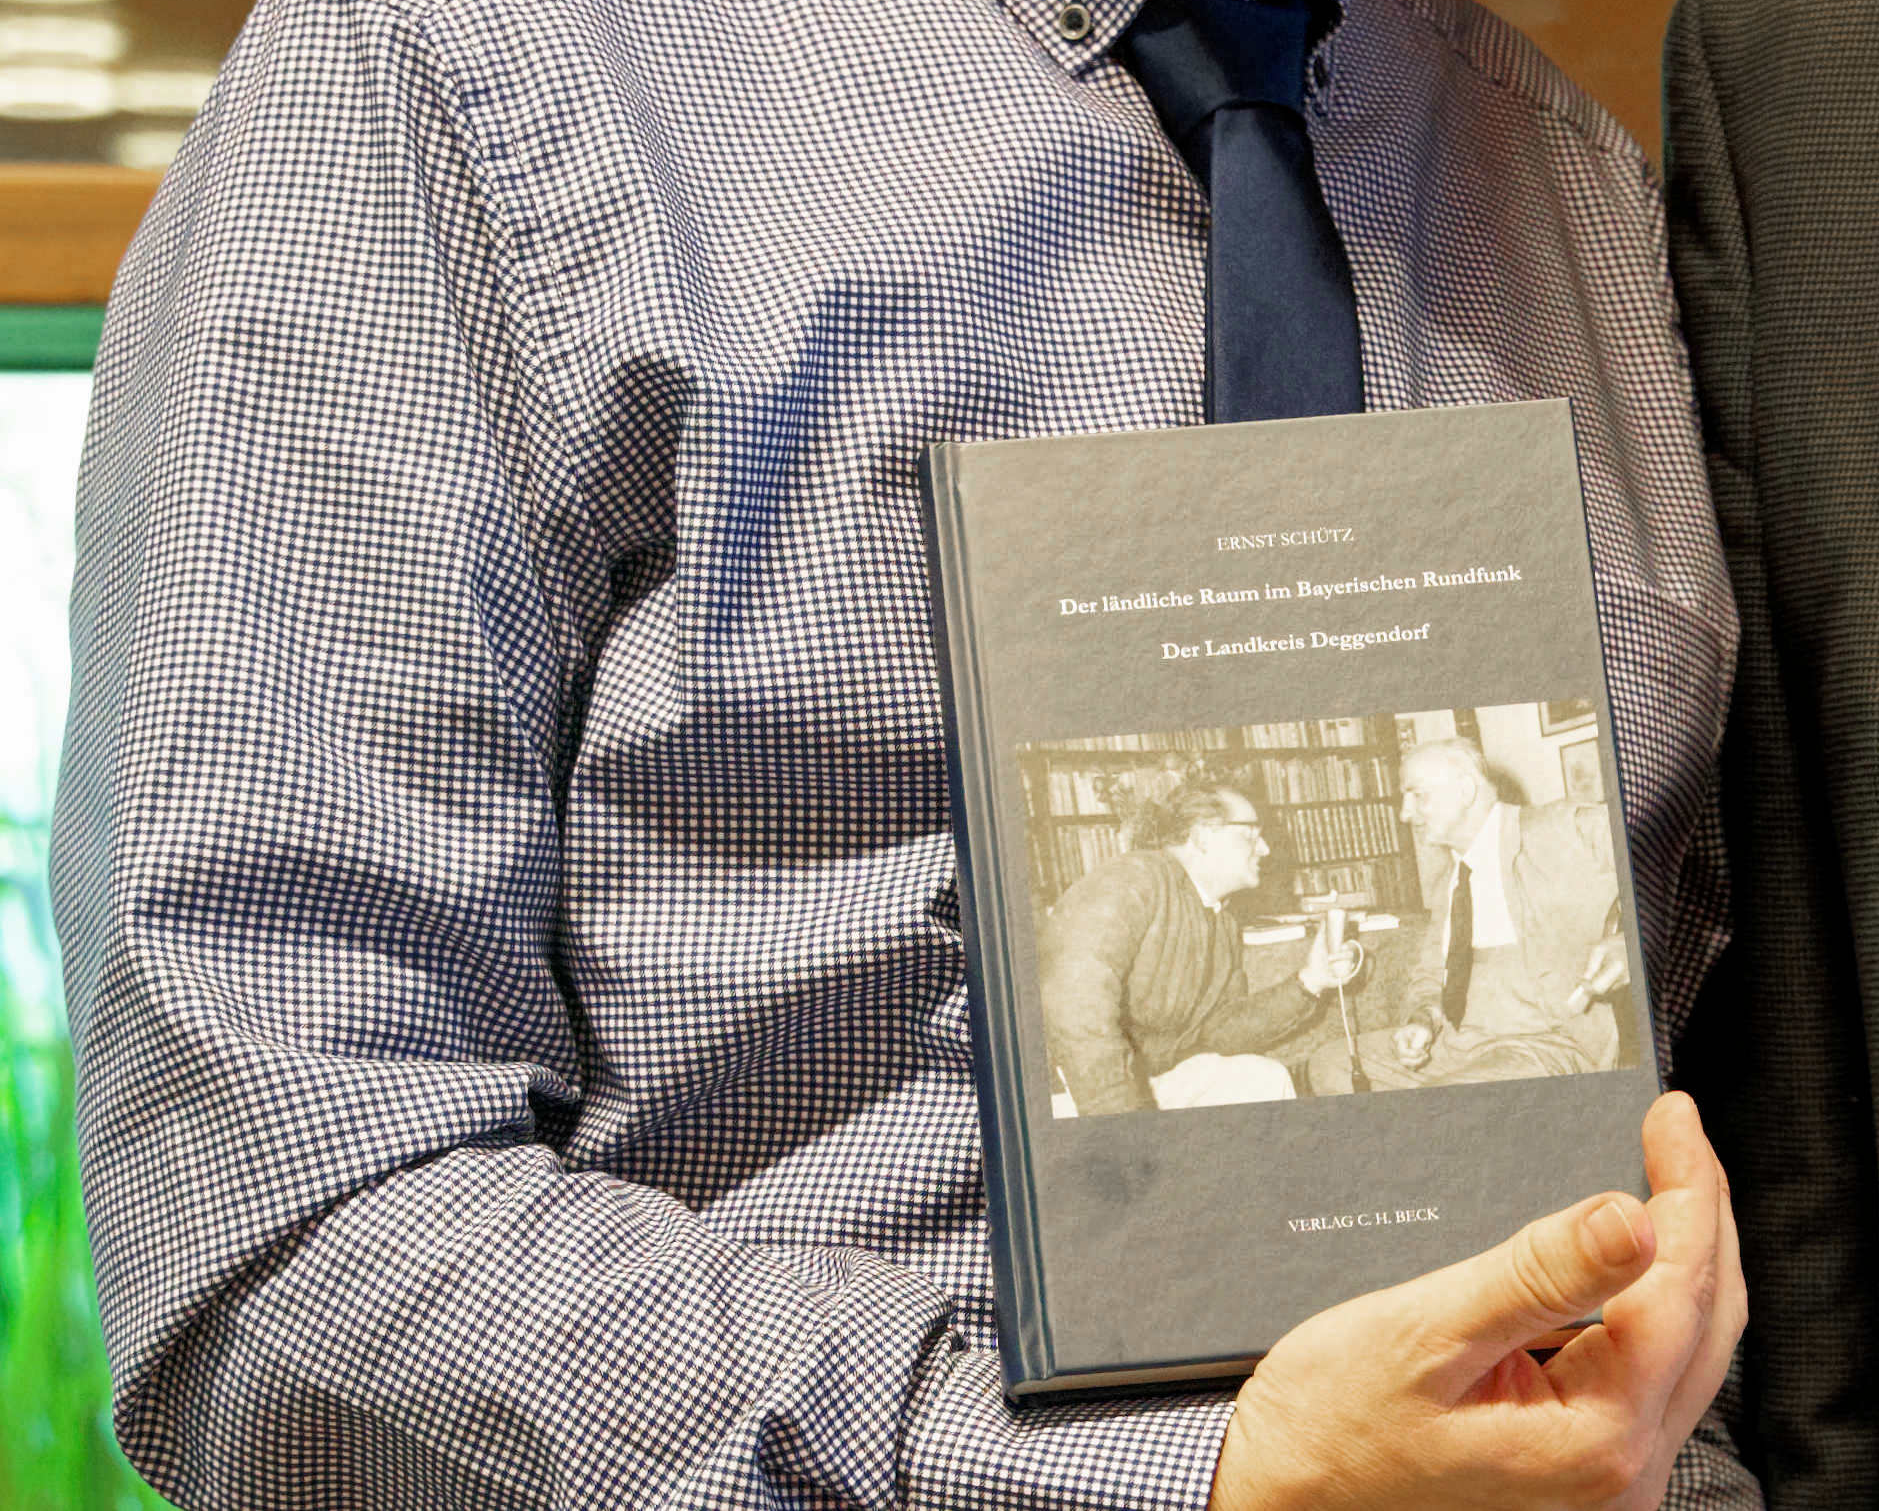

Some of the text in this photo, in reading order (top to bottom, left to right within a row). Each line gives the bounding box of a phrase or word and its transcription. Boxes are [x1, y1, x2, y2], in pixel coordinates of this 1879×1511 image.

[1216, 528, 1353, 551] ERNST SCHÜTZ
[1059, 566, 1522, 616] Der ländliche Raum im Bayerischen Rundfunk
[1161, 623, 1431, 660] Der Landkreis Deggendorf
[1288, 1207, 1440, 1233] VERLAG C. H. BECK
